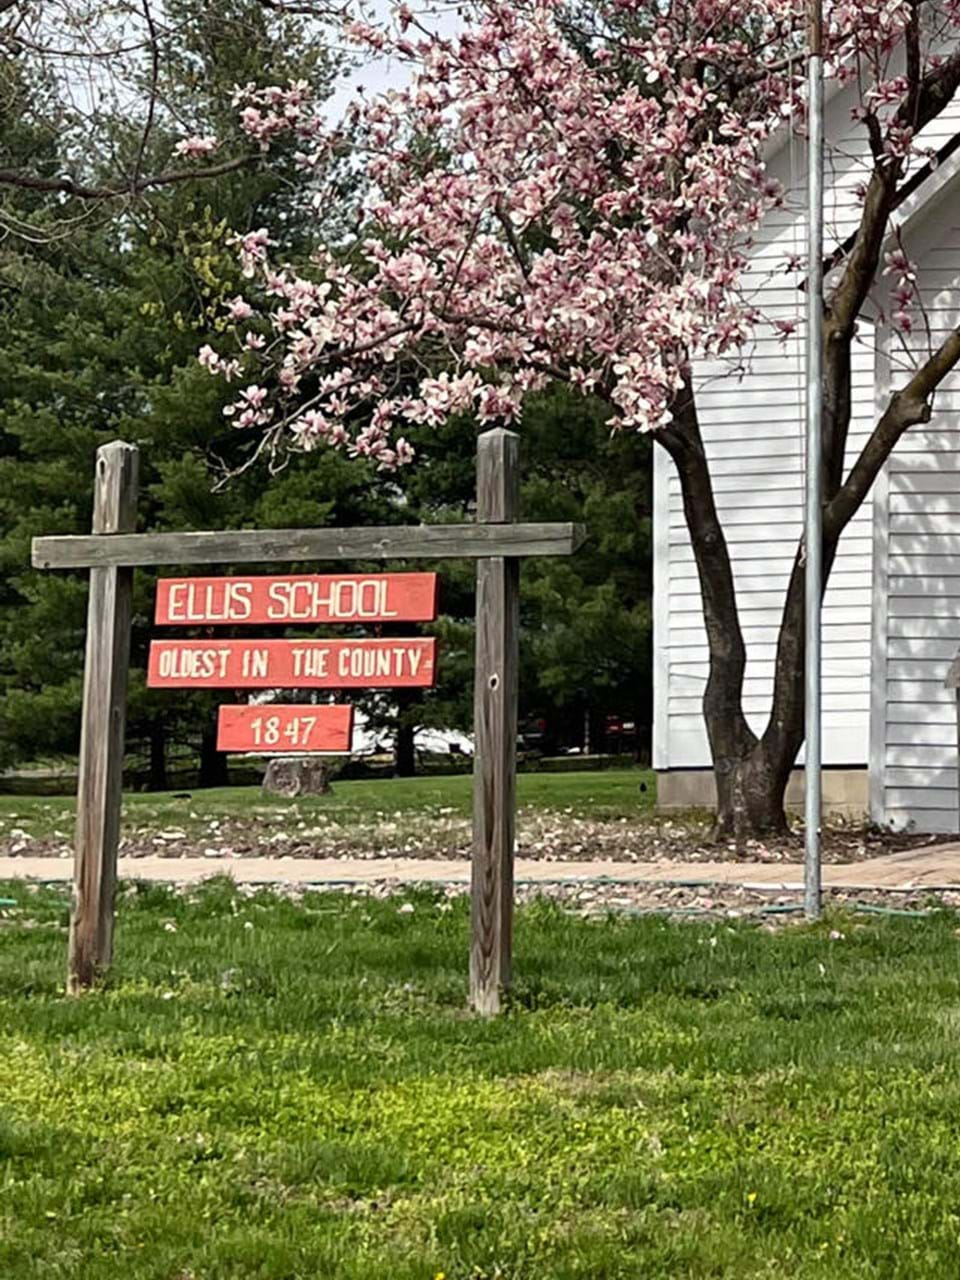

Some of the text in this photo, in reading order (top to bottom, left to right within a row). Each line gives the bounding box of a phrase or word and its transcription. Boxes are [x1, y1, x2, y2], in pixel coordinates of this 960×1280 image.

[168, 580, 398, 620] ELLIS SCHOOL
[159, 647, 422, 678] OLDEST IN THE COUNTY
[250, 716, 317, 745] 1847
